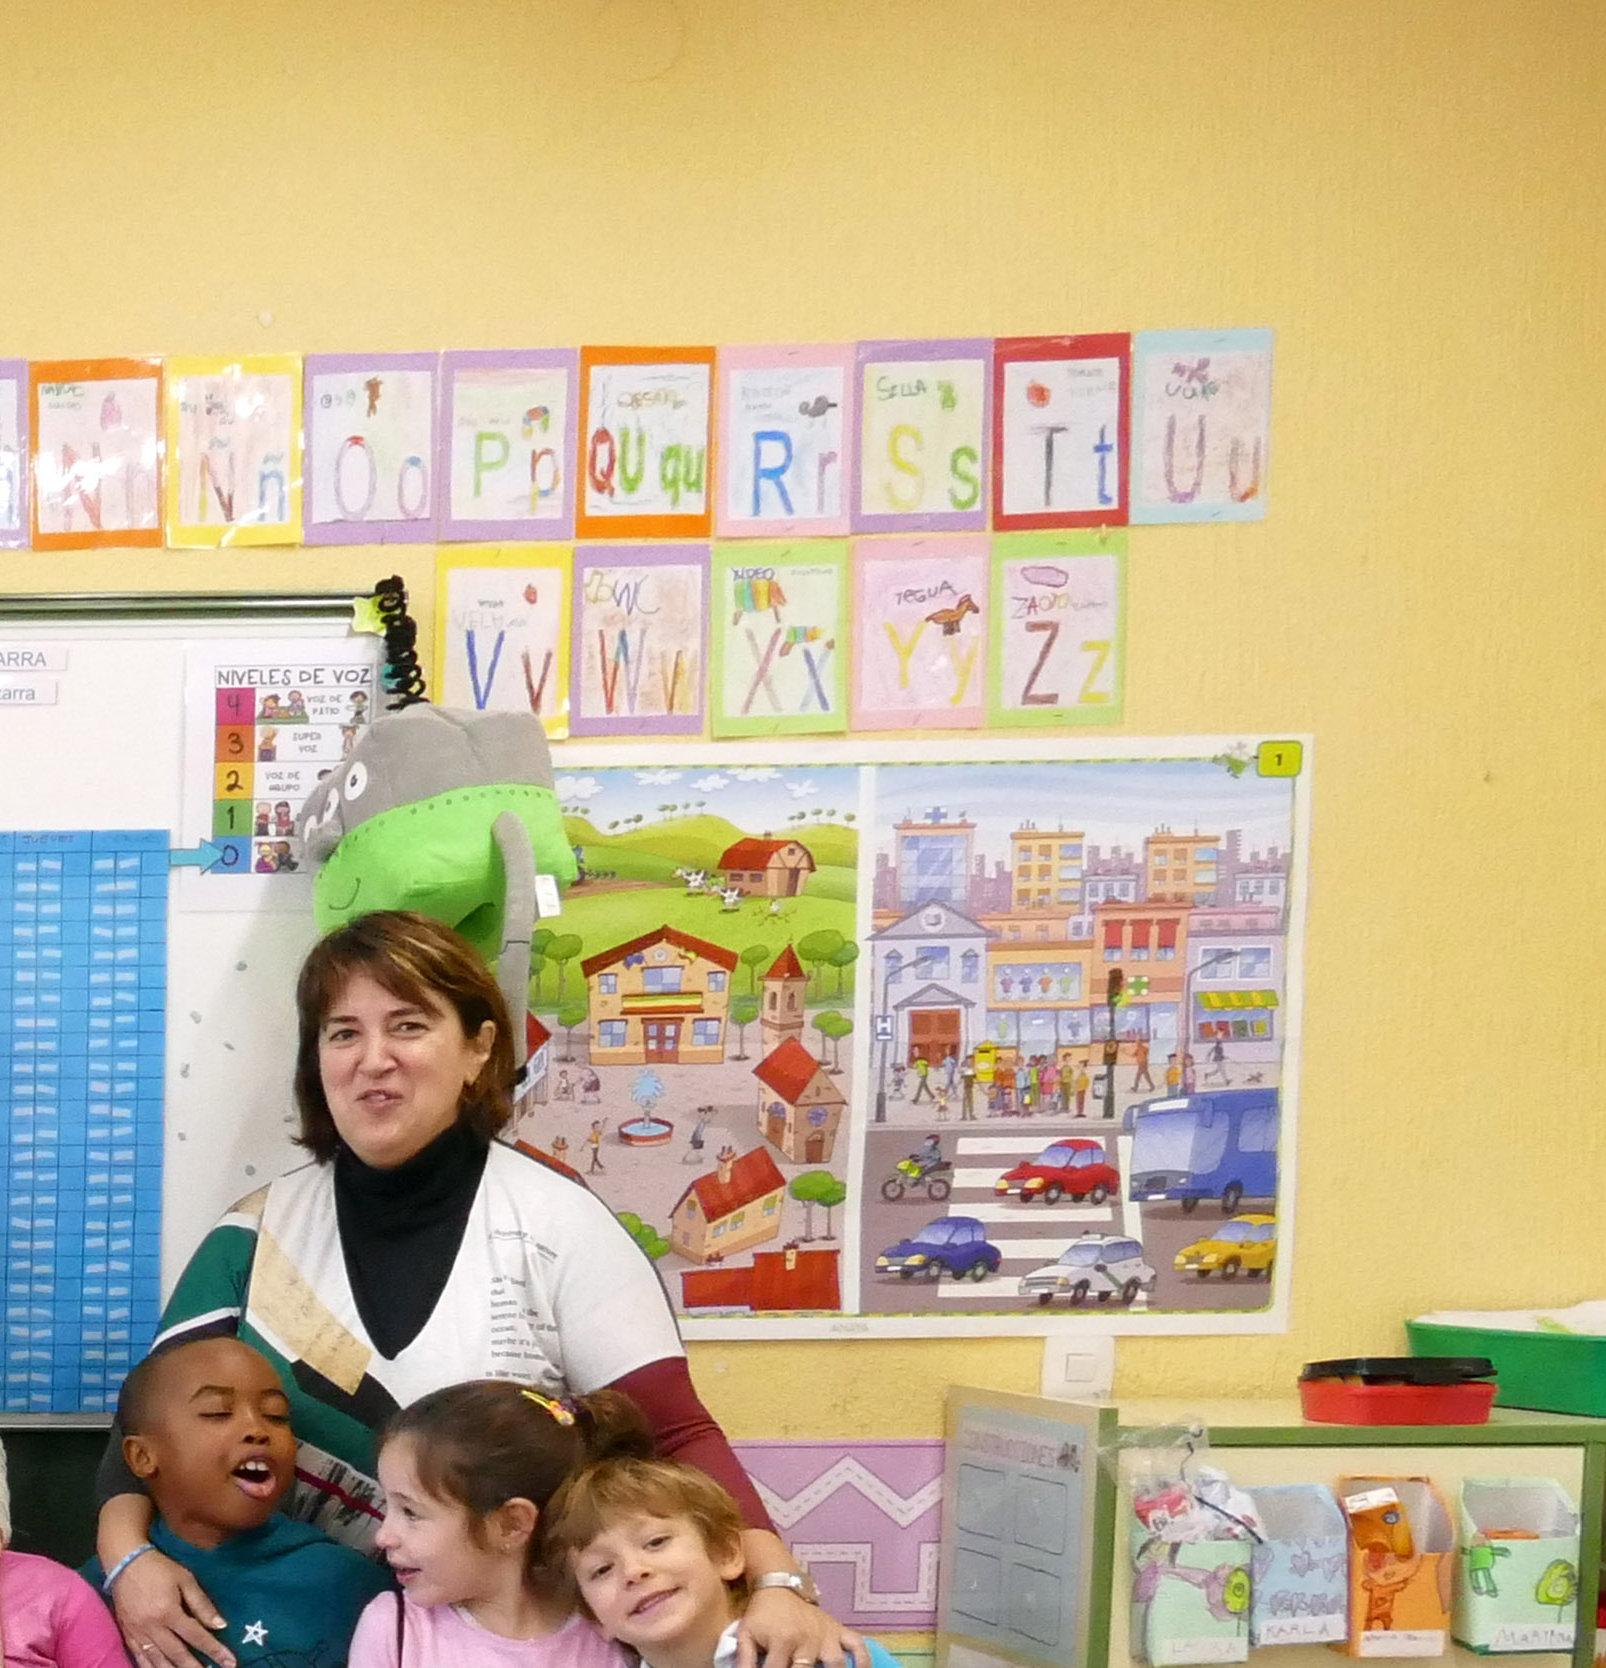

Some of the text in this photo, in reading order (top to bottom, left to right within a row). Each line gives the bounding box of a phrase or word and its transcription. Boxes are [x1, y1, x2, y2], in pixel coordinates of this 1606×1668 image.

[217, 668, 374, 687] NIVELES DE VOZ
[226, 693, 243, 717] 4
[227, 732, 245, 756] 3
[1272, 751, 1284, 768] 1
[224, 769, 245, 792] 2
[227, 805, 235, 831] 1
[221, 844, 239, 867] 0
